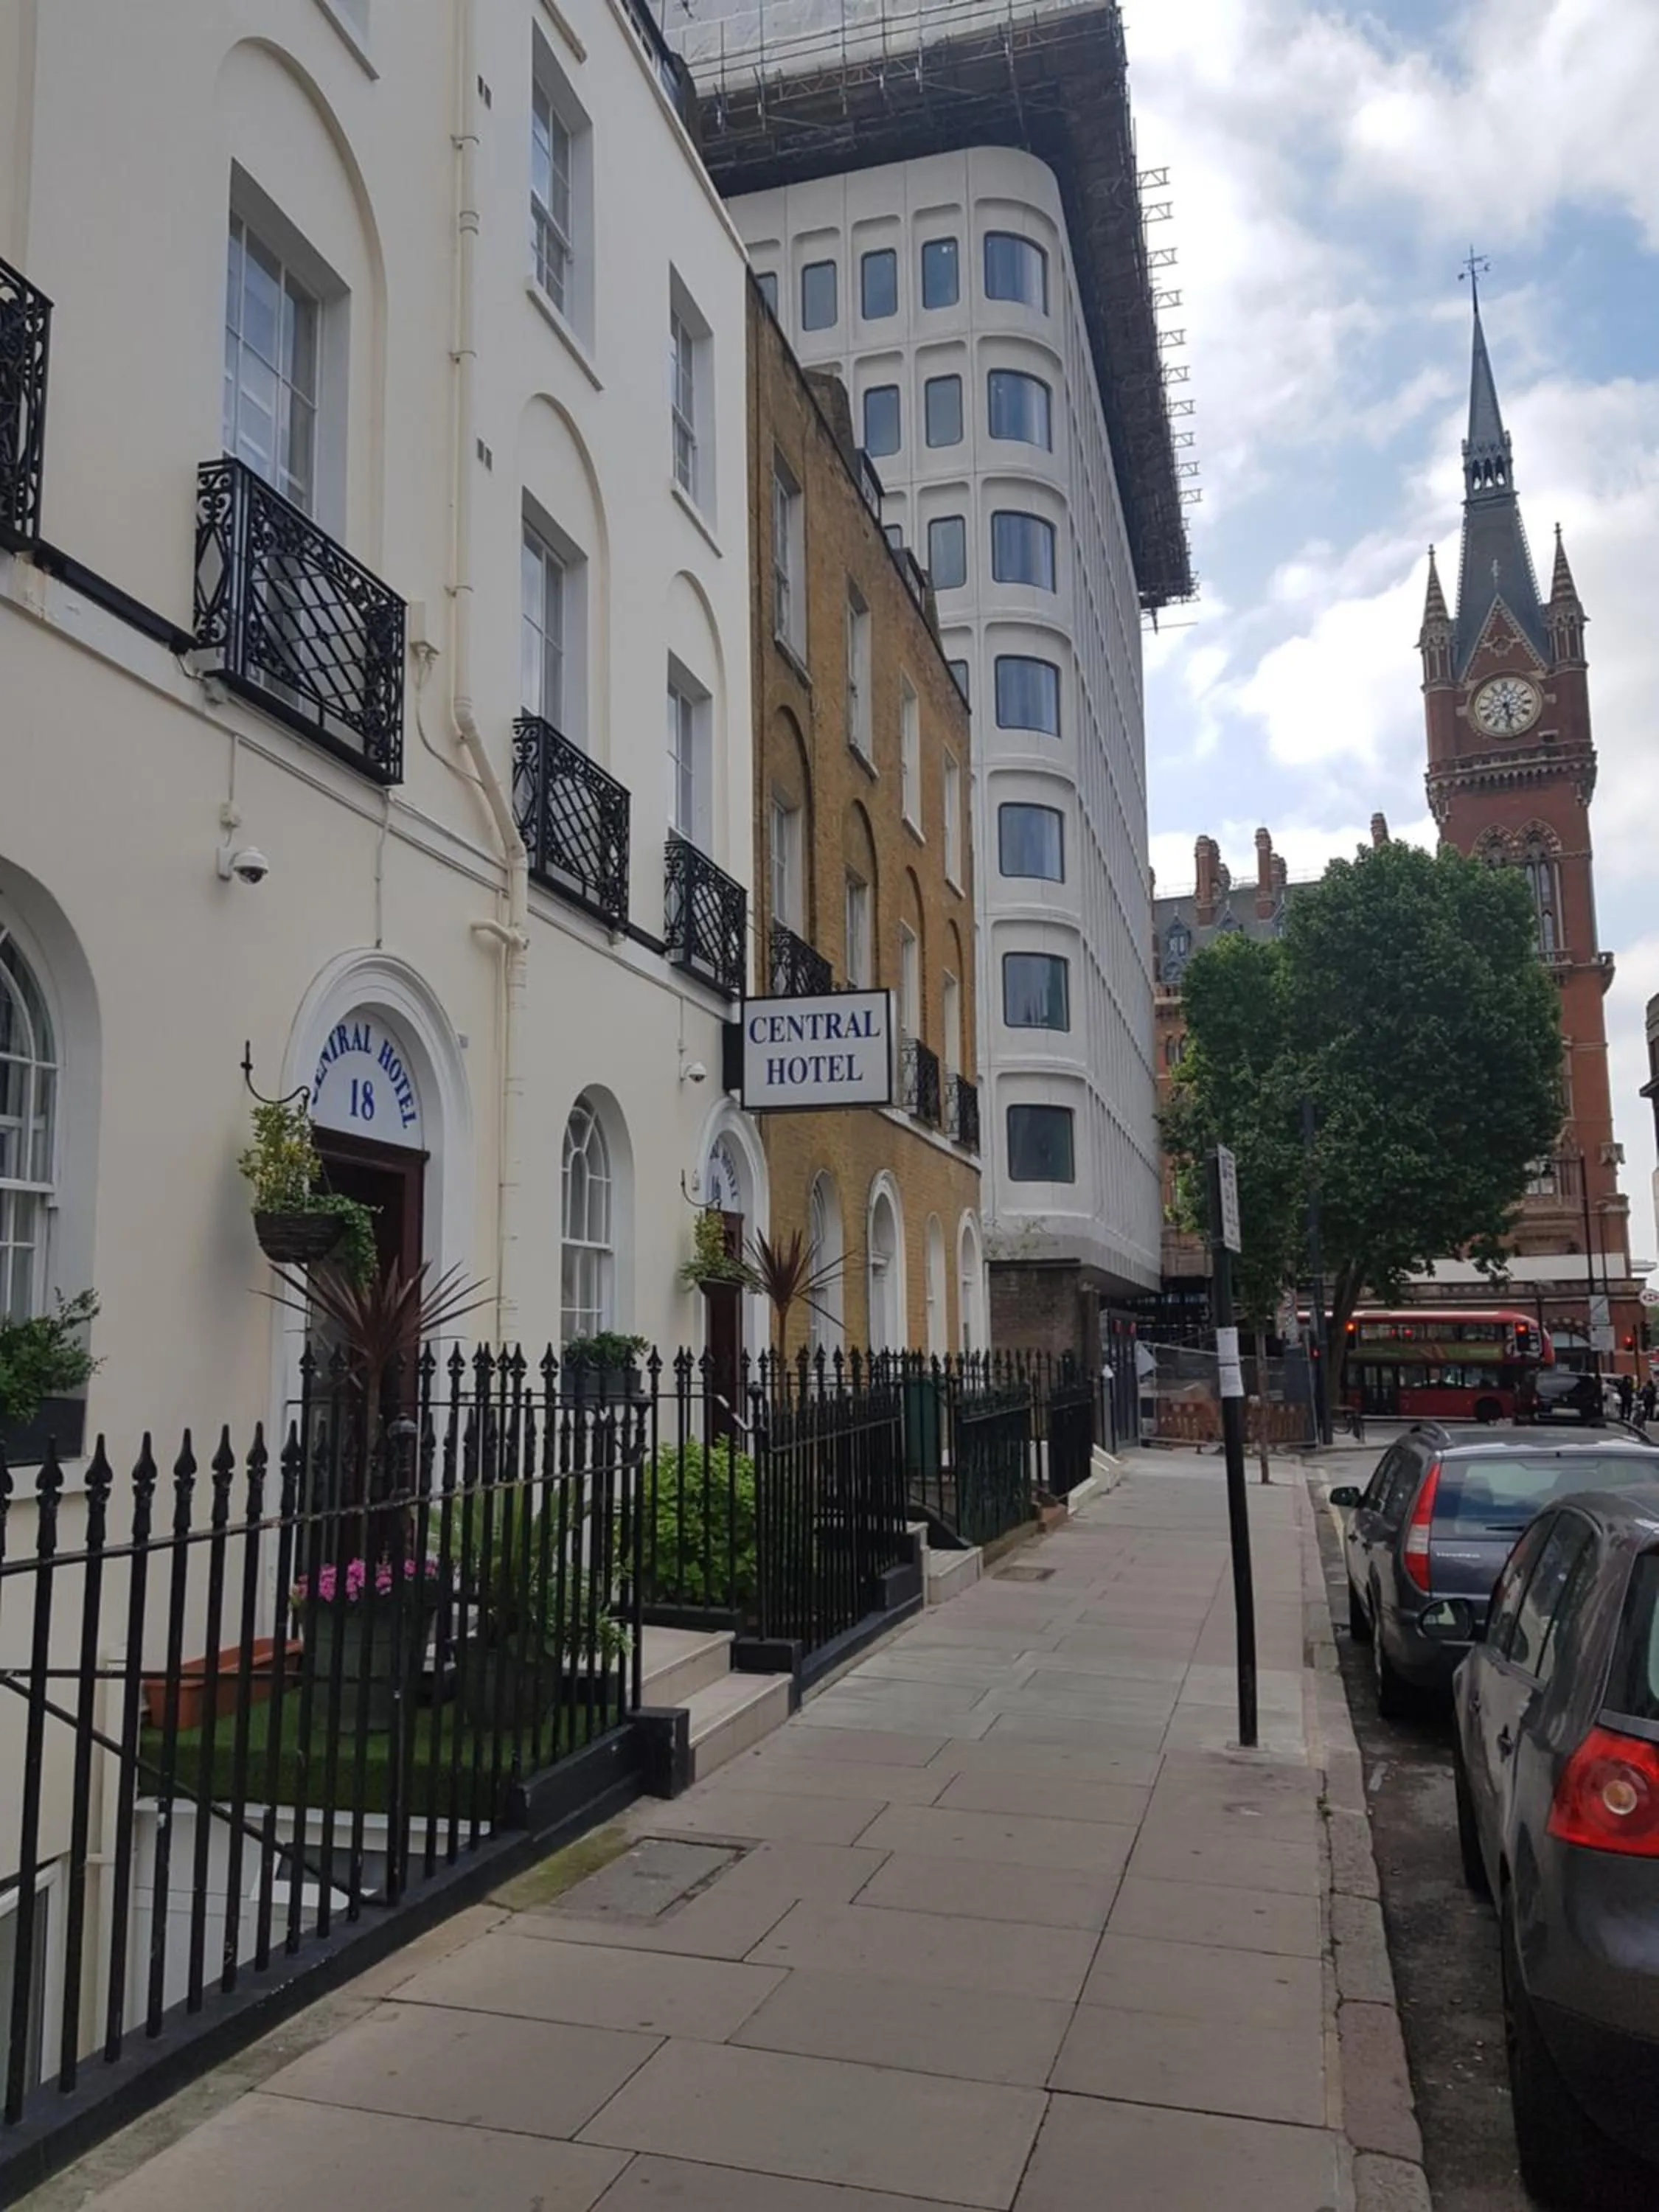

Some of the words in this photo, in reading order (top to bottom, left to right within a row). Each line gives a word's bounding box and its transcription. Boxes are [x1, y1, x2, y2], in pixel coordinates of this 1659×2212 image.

[748, 1010, 881, 1044] CENTRAL
[378, 1038, 417, 1129] HOTEL
[766, 1054, 863, 1085] HOTEL
[349, 1078, 375, 1121] 18
